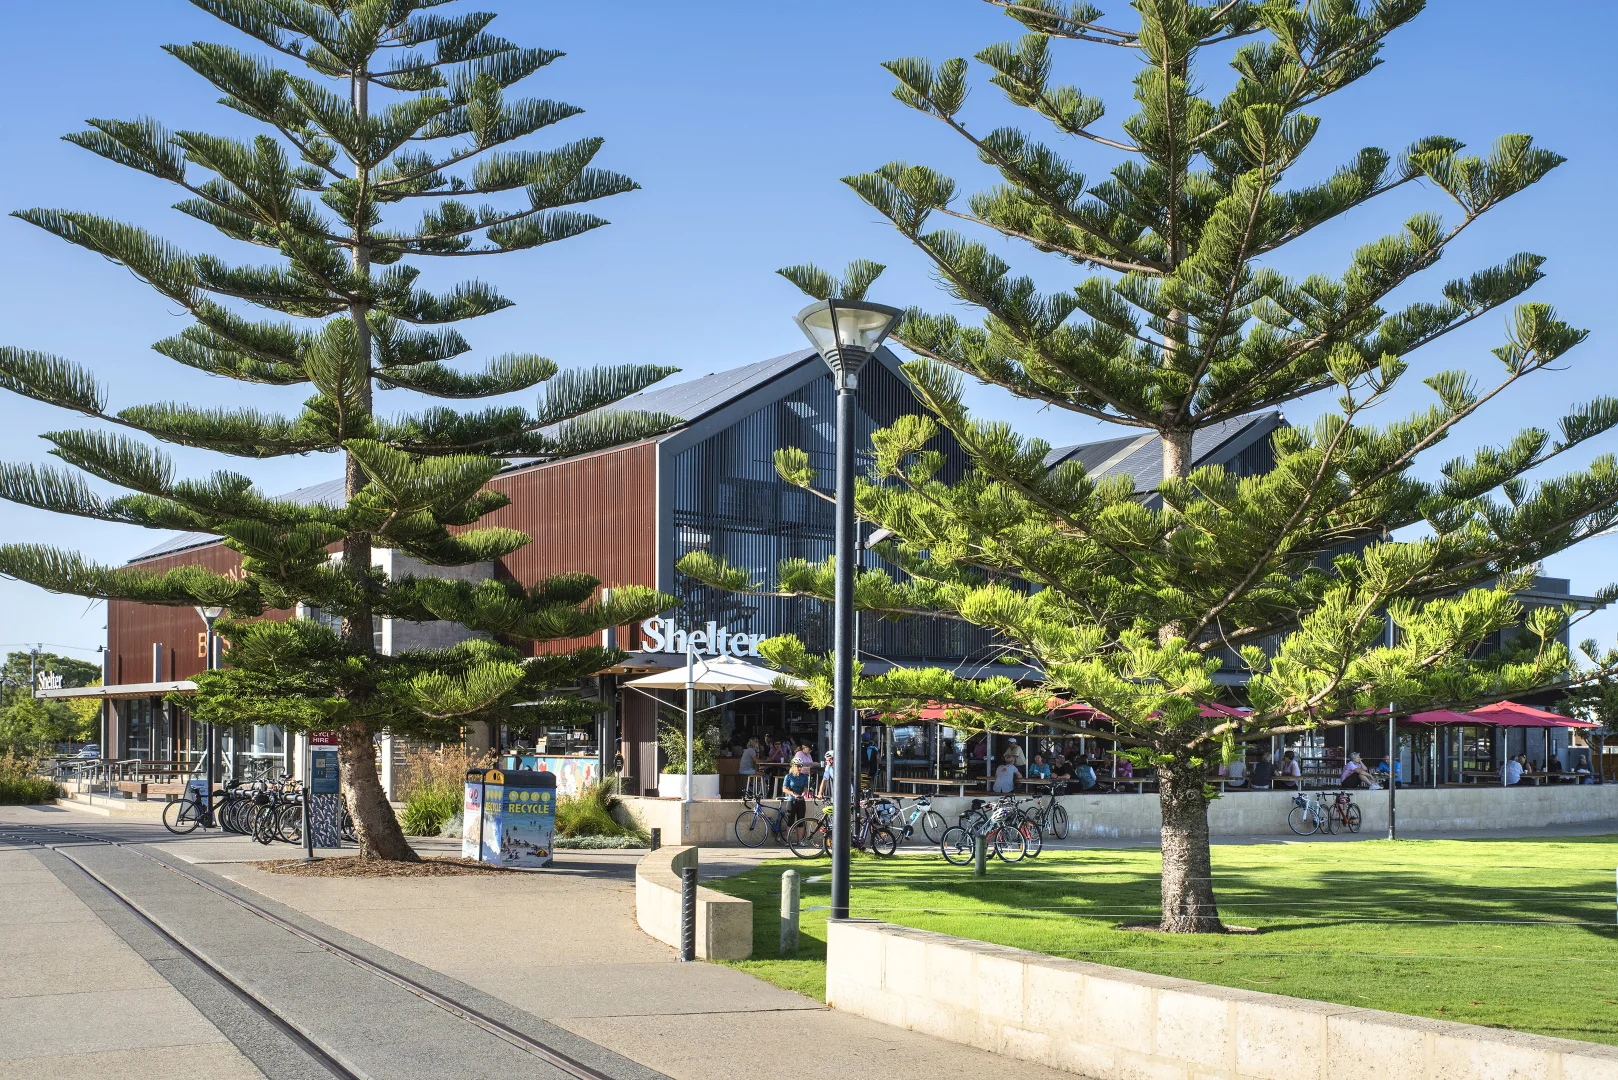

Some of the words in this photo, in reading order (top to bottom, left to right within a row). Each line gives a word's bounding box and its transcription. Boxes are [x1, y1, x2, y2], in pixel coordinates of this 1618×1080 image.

[640, 617, 766, 658] Shelter
[38, 670, 63, 690] Shelter
[508, 803, 549, 814] RECYCLE
